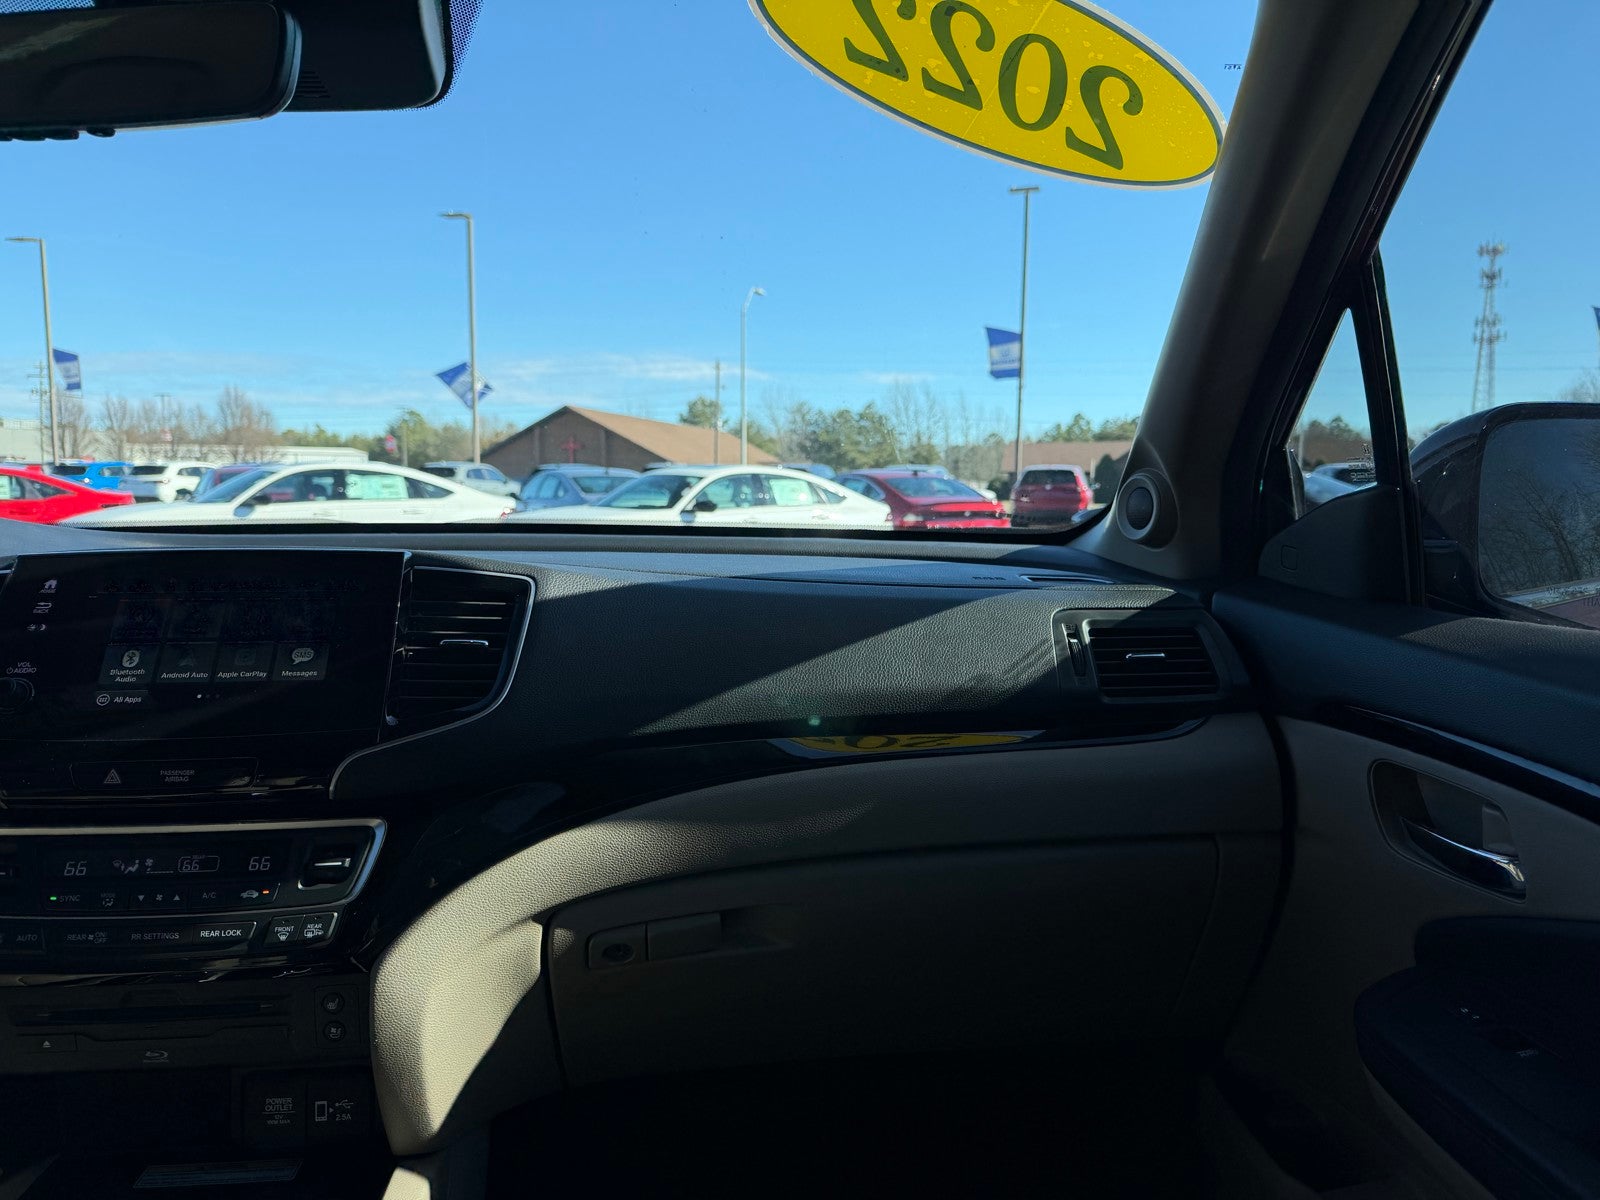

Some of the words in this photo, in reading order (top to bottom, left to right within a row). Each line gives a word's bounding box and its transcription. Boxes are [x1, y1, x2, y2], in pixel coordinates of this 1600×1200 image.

[293, 650, 313, 659] SMS
[161, 671, 189, 679] Android
[191, 671, 208, 679] Auto
[217, 670, 238, 679] Apple
[239, 670, 267, 679] CarPlay
[281, 669, 318, 678] Messages
[125, 696, 142, 704] Apps
[182, 859, 200, 871] 66
[248, 856, 272, 871] 66
[64, 860, 88, 877] 66
[59, 894, 81, 902] SYNC
[202, 891, 217, 899] A/C
[16, 933, 38, 942] AUTO
[66, 933, 87, 941] REAR
[143, 932, 180, 940] SETTINGS
[200, 929, 220, 938] REAR
[221, 929, 242, 937] LOCK
[265, 1097, 292, 1105] POWER
[264, 1104, 293, 1112] OUTLET
[335, 1113, 353, 1121] 2.5A
